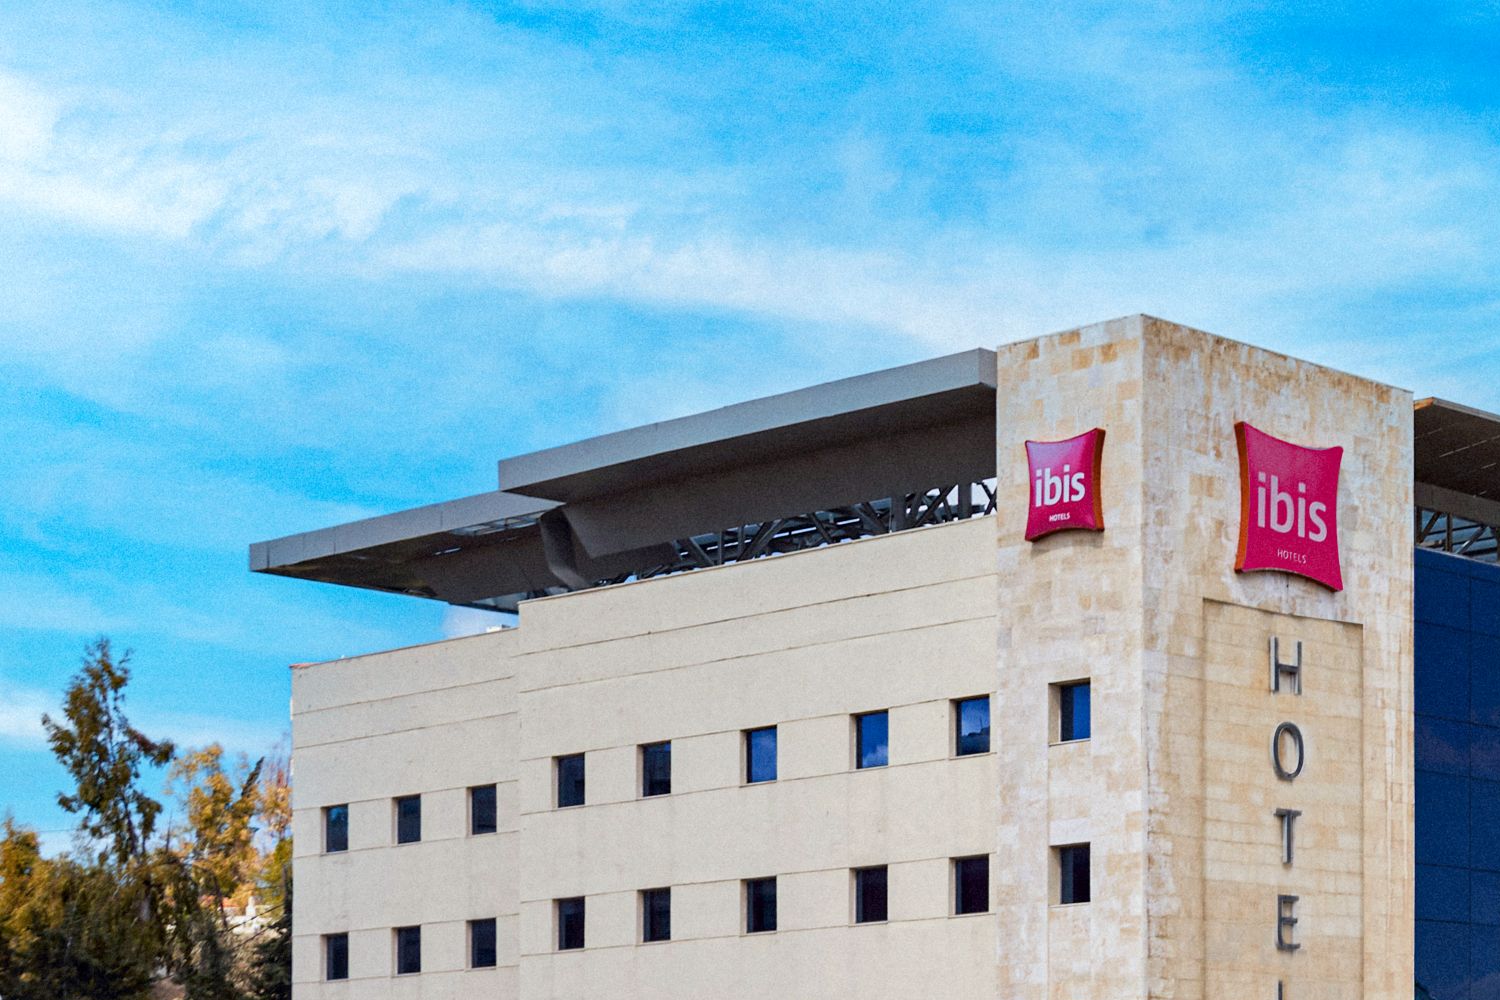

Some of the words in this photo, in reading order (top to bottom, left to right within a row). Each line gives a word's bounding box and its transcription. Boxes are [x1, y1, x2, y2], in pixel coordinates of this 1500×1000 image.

[1035, 464, 1085, 507] ibis
[1049, 512, 1071, 522] HOTELS
[1257, 471, 1328, 543] ibis
[1277, 548, 1307, 565] HOTELS
